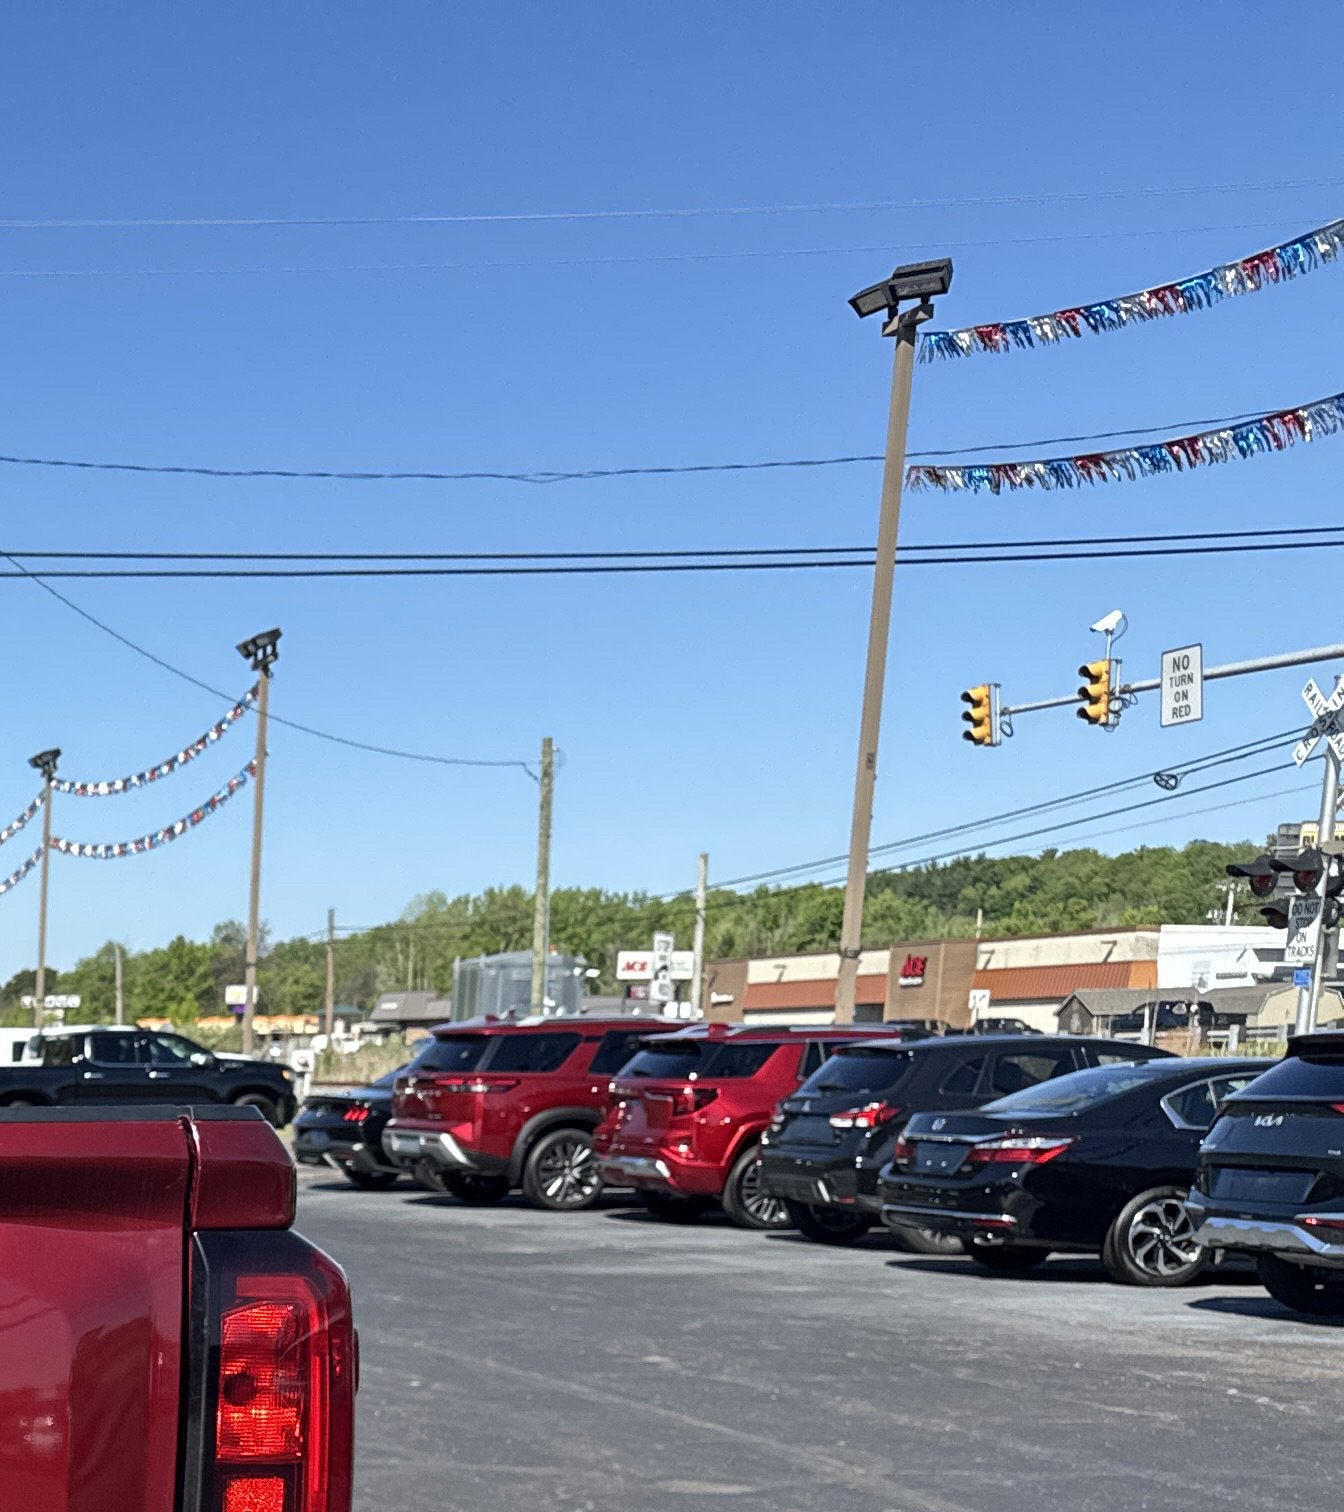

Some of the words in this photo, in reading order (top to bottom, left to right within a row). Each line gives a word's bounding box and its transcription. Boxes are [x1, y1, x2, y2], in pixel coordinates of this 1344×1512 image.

[1172, 654, 1190, 673] NO
[1169, 672, 1193, 689] TURN
[1174, 689, 1189, 703] ON
[1172, 704, 1191, 719] RED
[1296, 931, 1307, 943] ON
[1287, 945, 1315, 957] TRACKS
